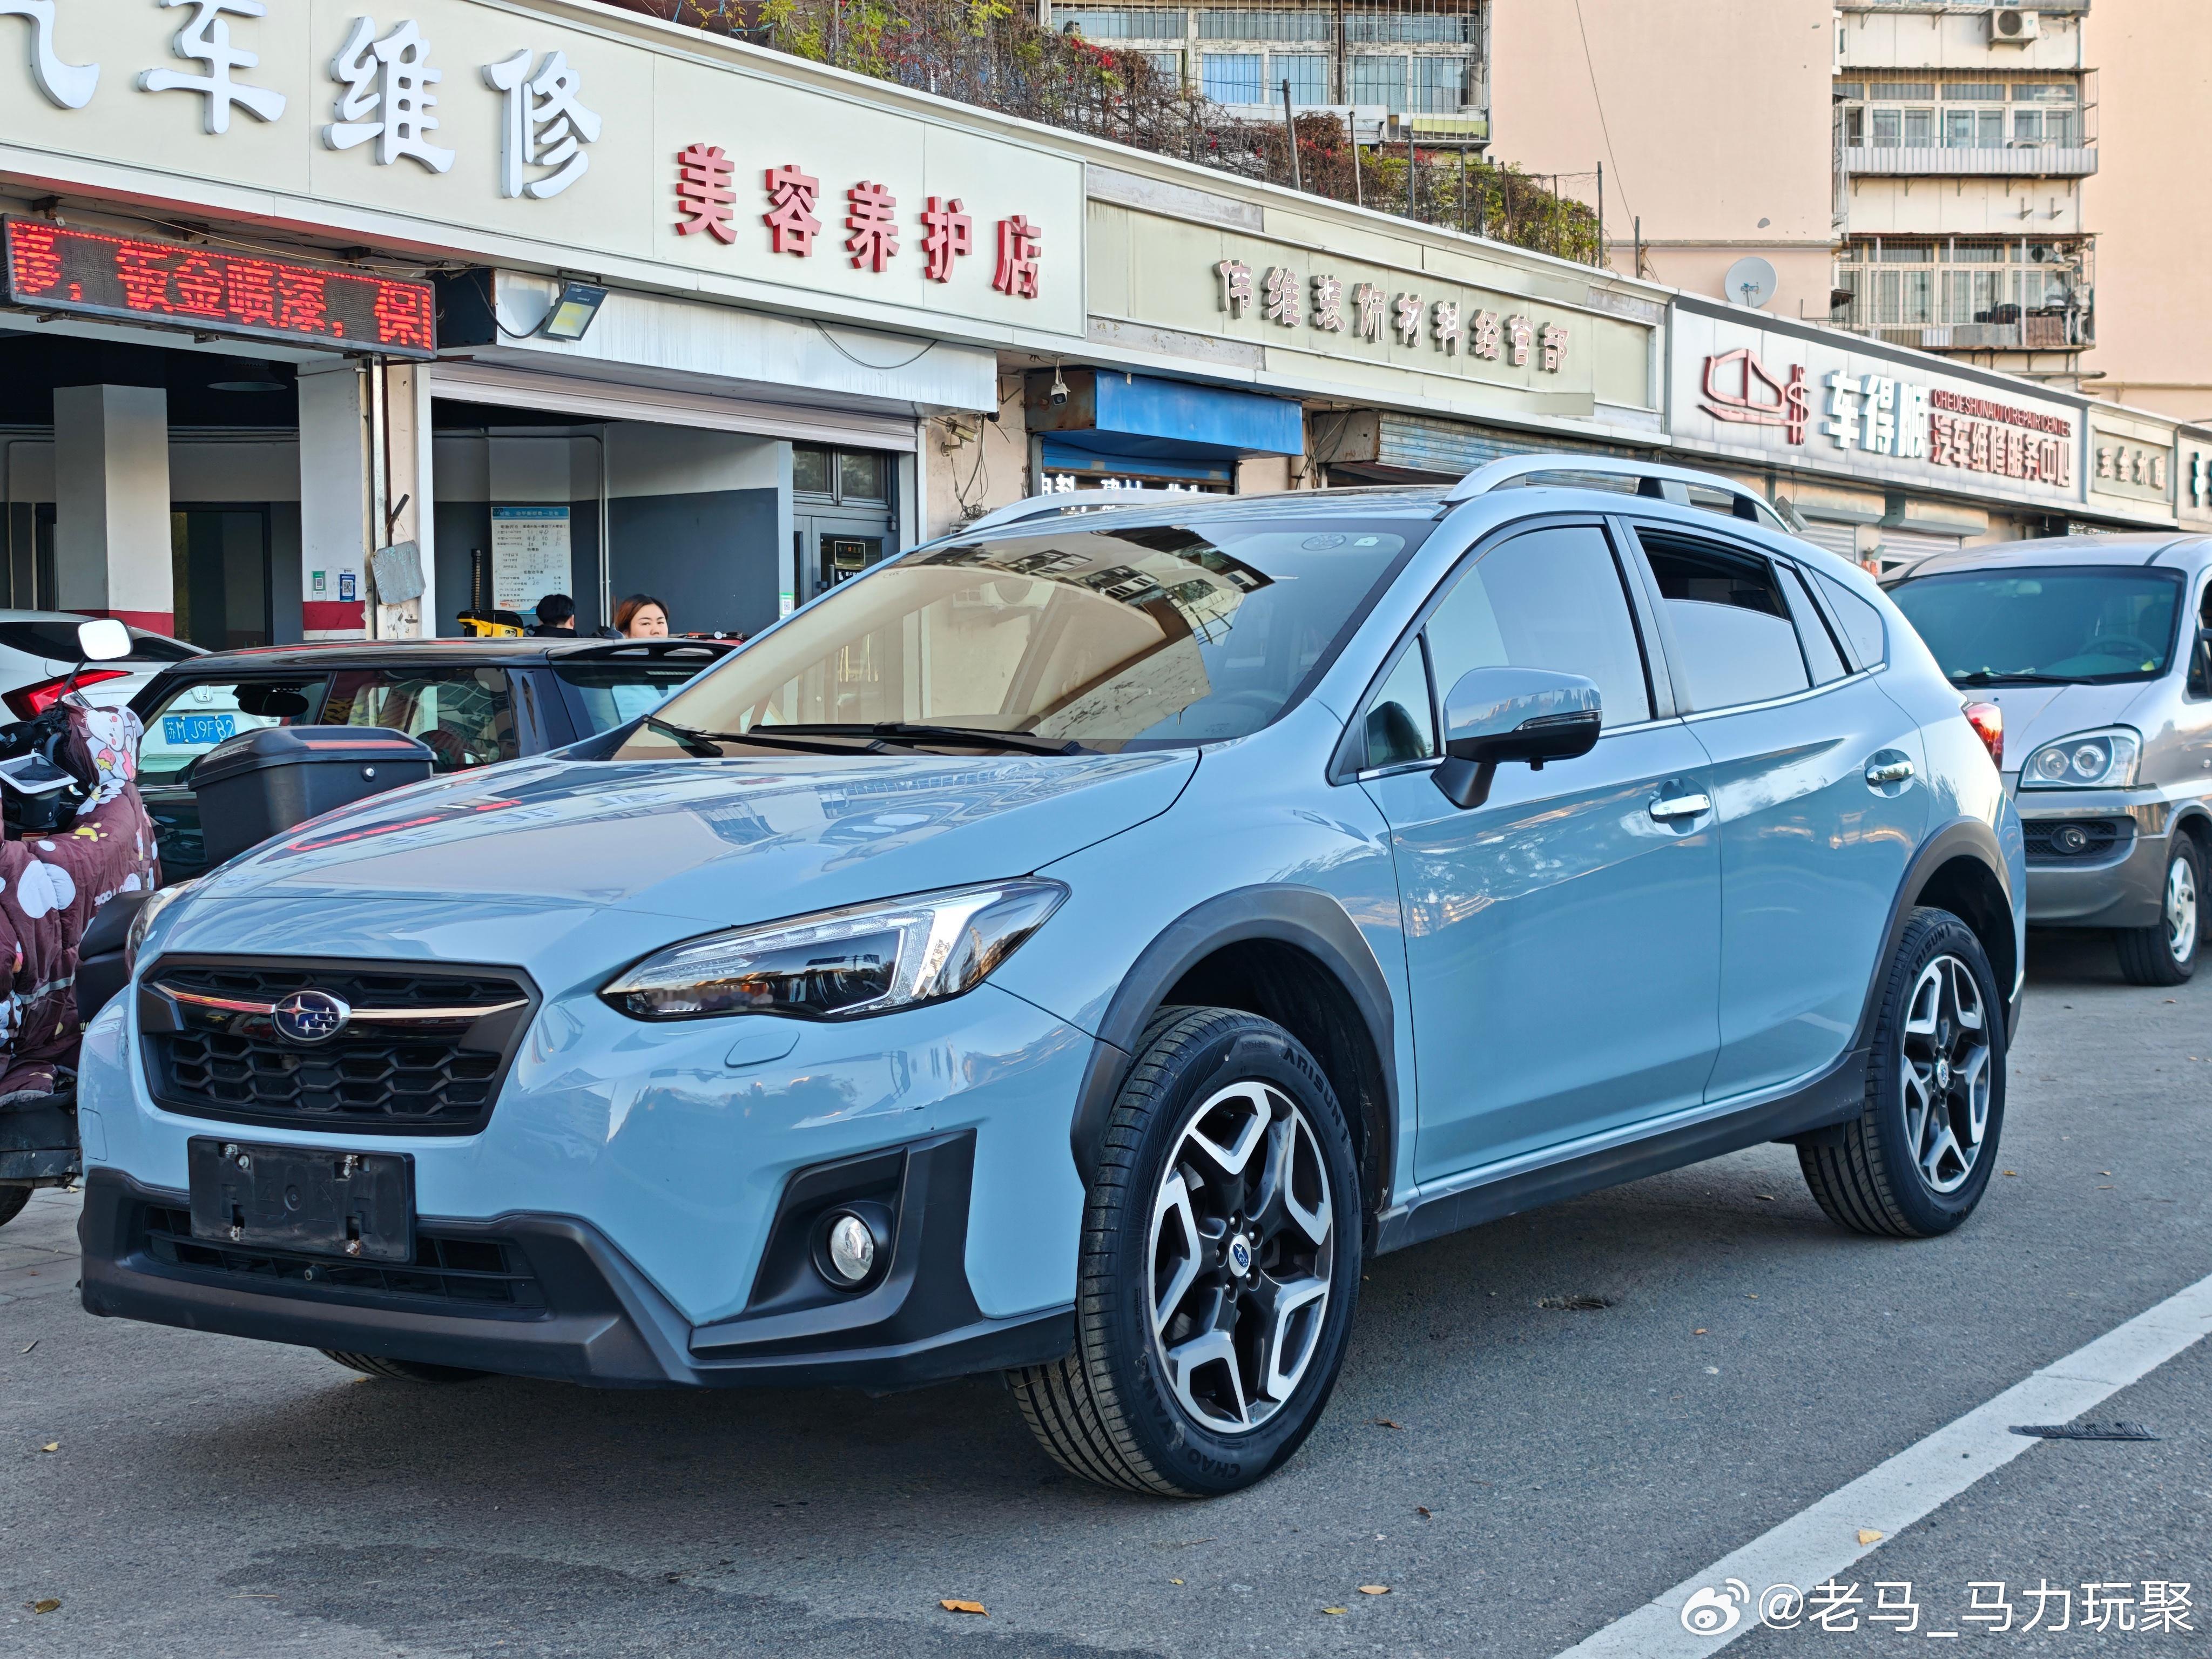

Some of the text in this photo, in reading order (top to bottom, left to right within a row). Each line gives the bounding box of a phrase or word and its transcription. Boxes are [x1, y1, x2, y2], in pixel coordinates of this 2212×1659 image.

[675, 143, 1042, 299] 美容养护店
[1213, 259, 1569, 373] 伟维装饰材料经营部
[1823, 370, 1930, 458] 车得顺
[1929, 413, 2070, 487] 汽车维修服务中心
[1283, 1048, 1342, 1127] ARISUN
